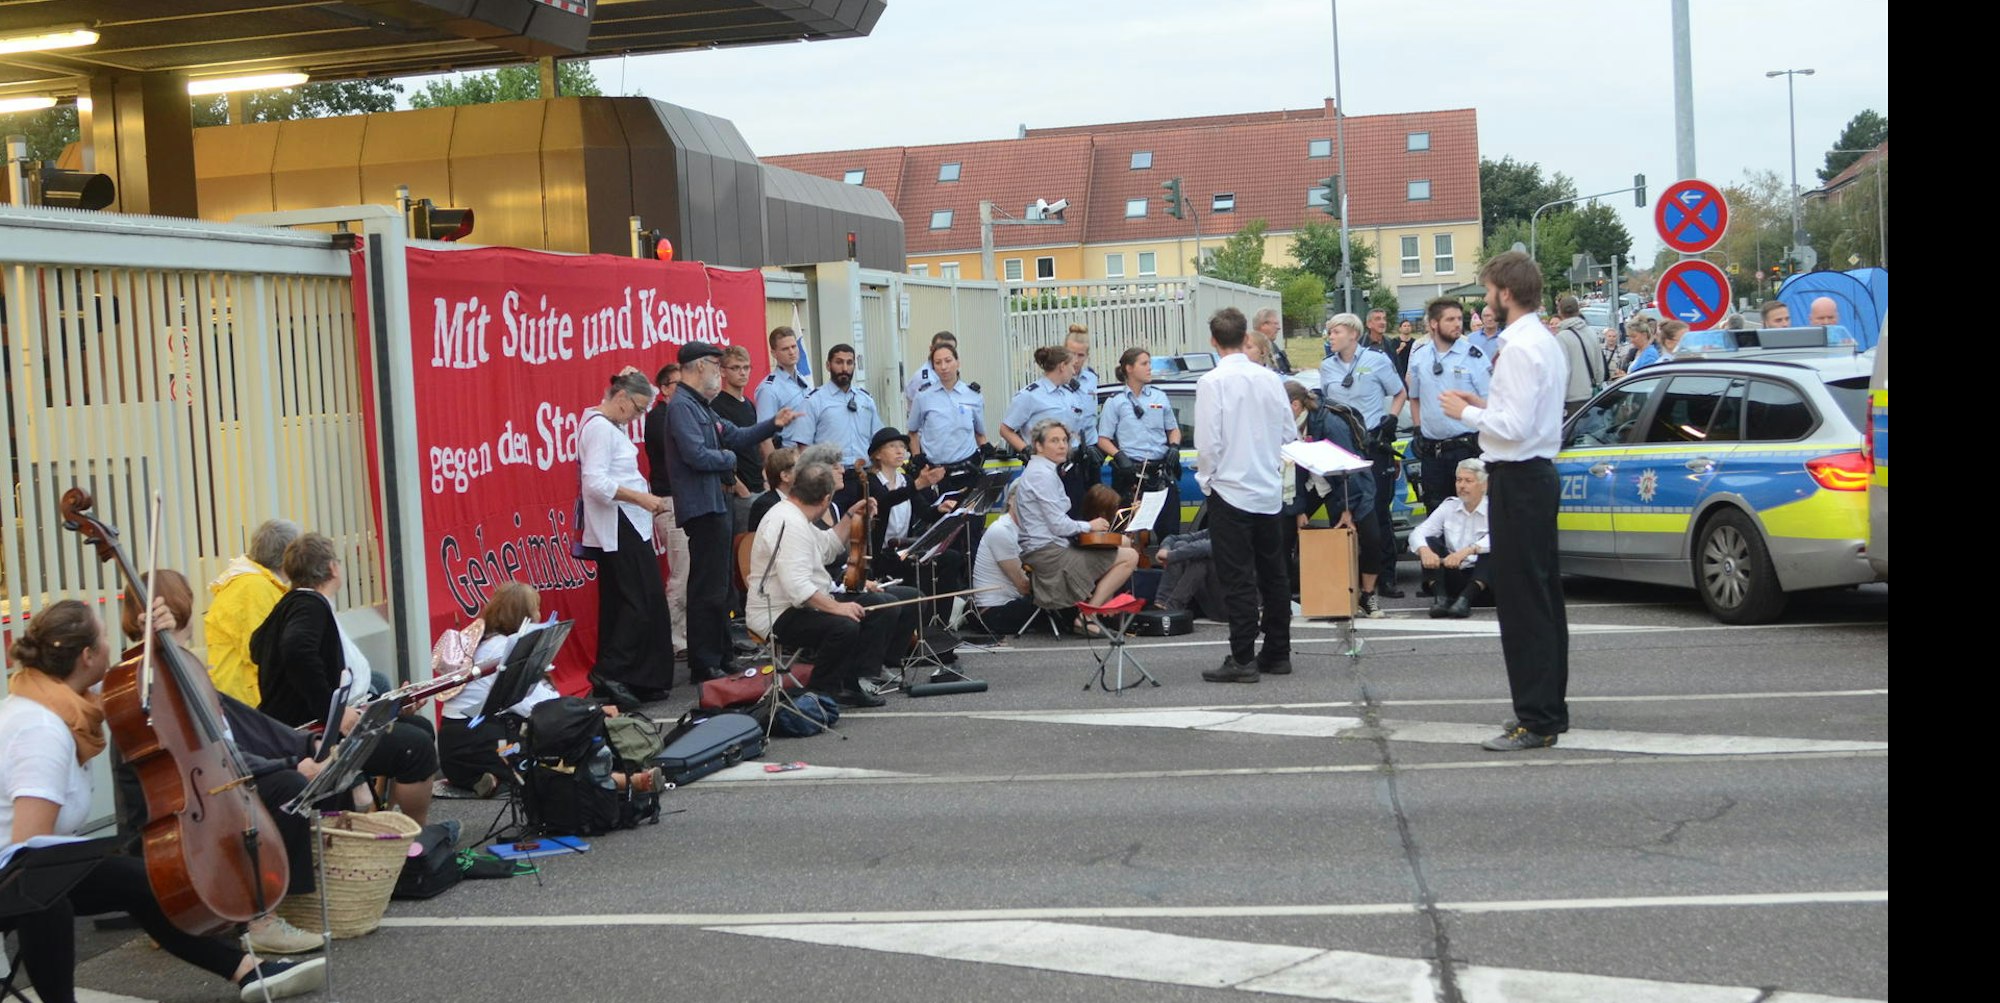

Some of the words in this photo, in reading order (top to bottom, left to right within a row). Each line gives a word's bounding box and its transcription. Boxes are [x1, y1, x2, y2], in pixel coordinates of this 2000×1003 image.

[431, 296, 491, 369] Mit
[502, 289, 574, 365] Suite
[581, 286, 635, 360] und
[638, 287, 731, 347] Kantate
[429, 446, 493, 494] gegen
[498, 420, 532, 466] den
[536, 401, 578, 471] Sta
[1560, 474, 1588, 500] ZEI
[441, 508, 598, 618] Geheimdi
